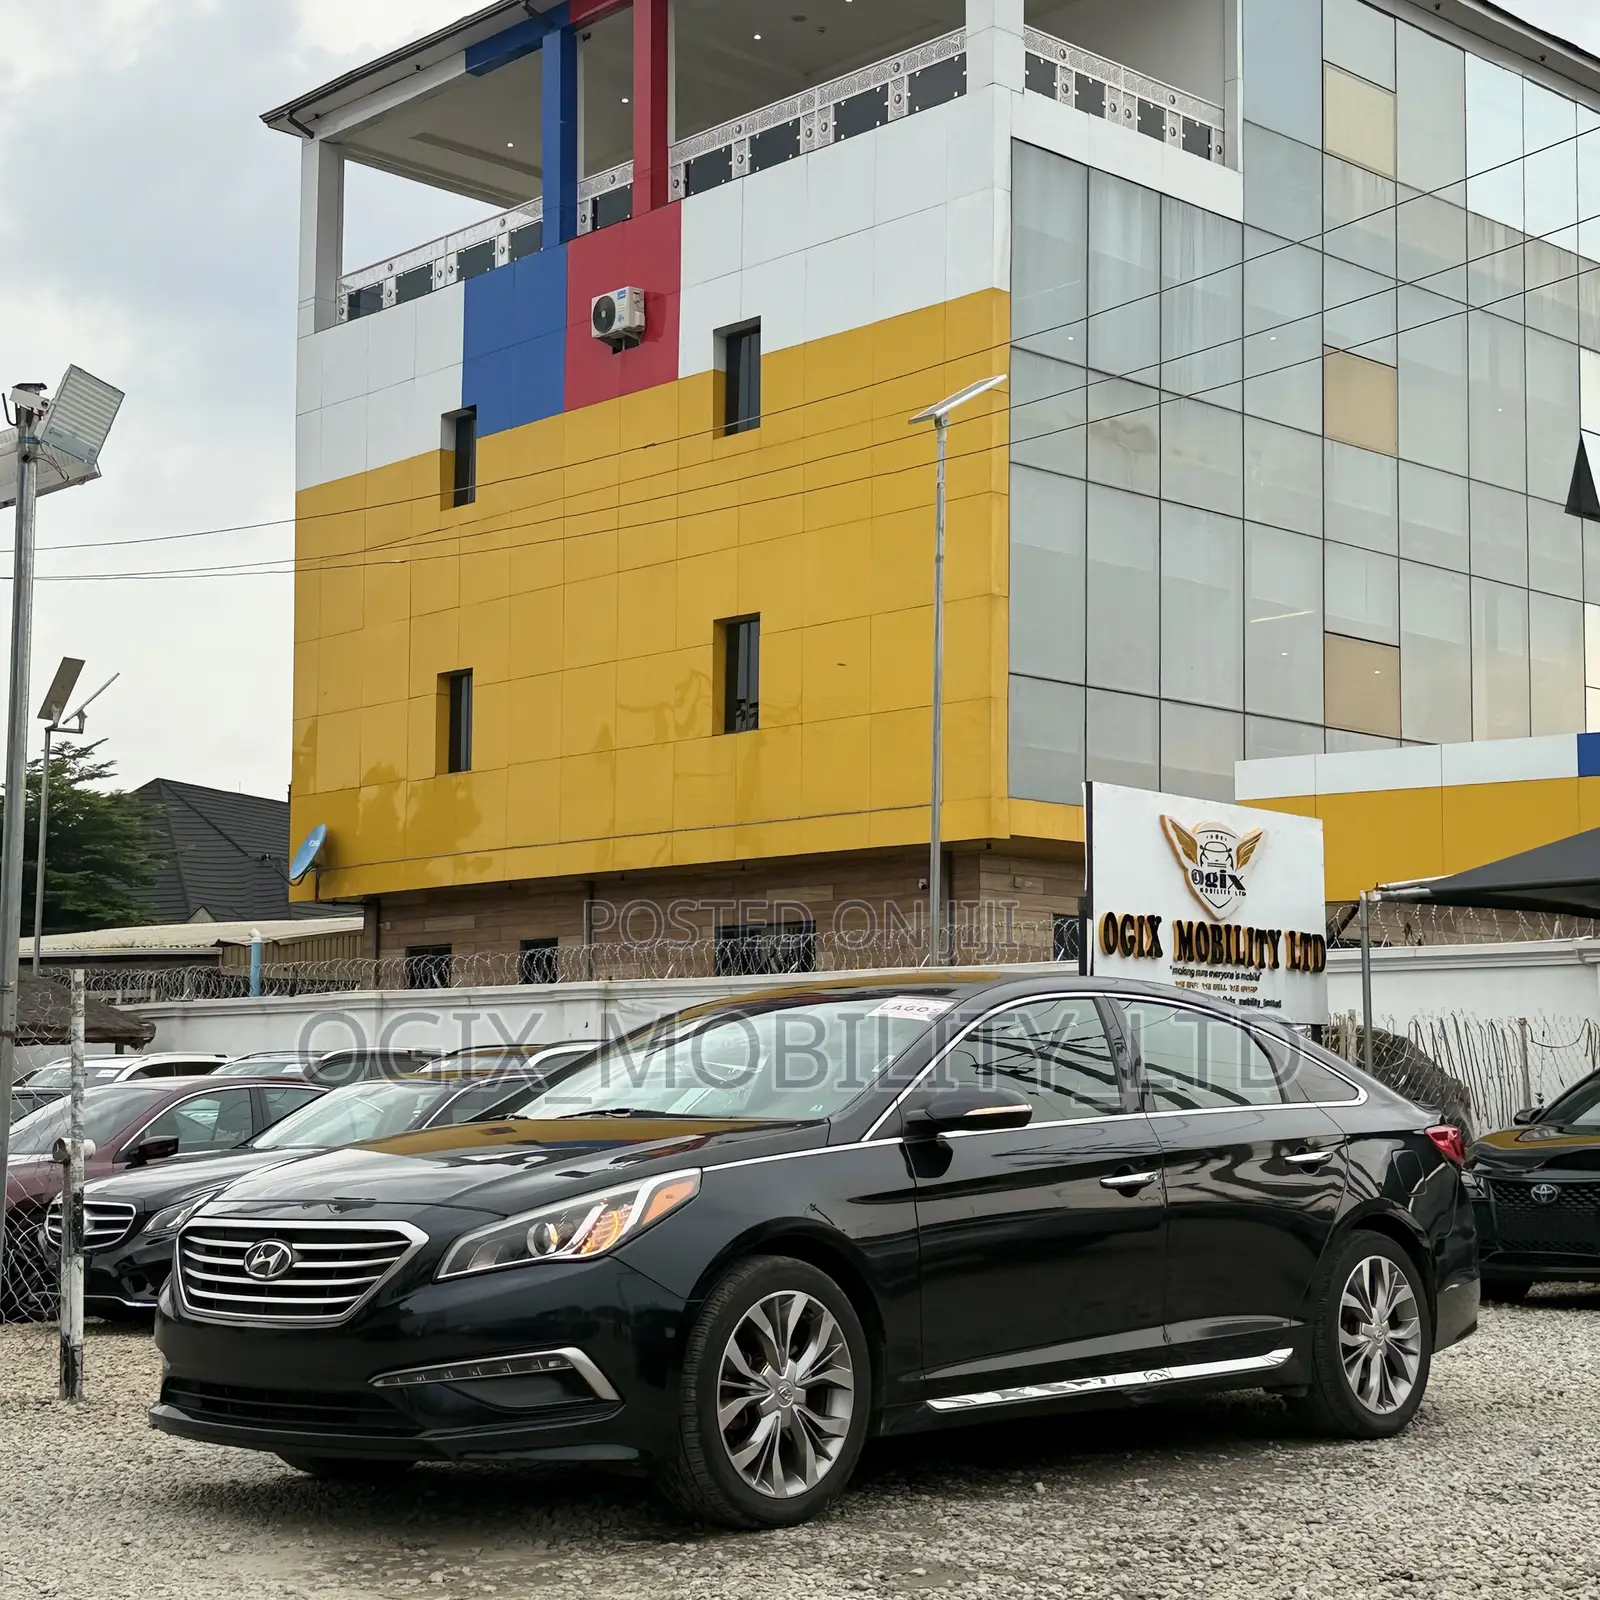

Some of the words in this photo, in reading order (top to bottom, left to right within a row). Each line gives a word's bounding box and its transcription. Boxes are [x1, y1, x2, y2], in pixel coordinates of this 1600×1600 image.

[1099, 911, 1163, 960] OGIX
[1172, 919, 1281, 969] MOBILITY
[1284, 930, 1327, 972] LTD
[879, 1004, 943, 1014] LAGOS
